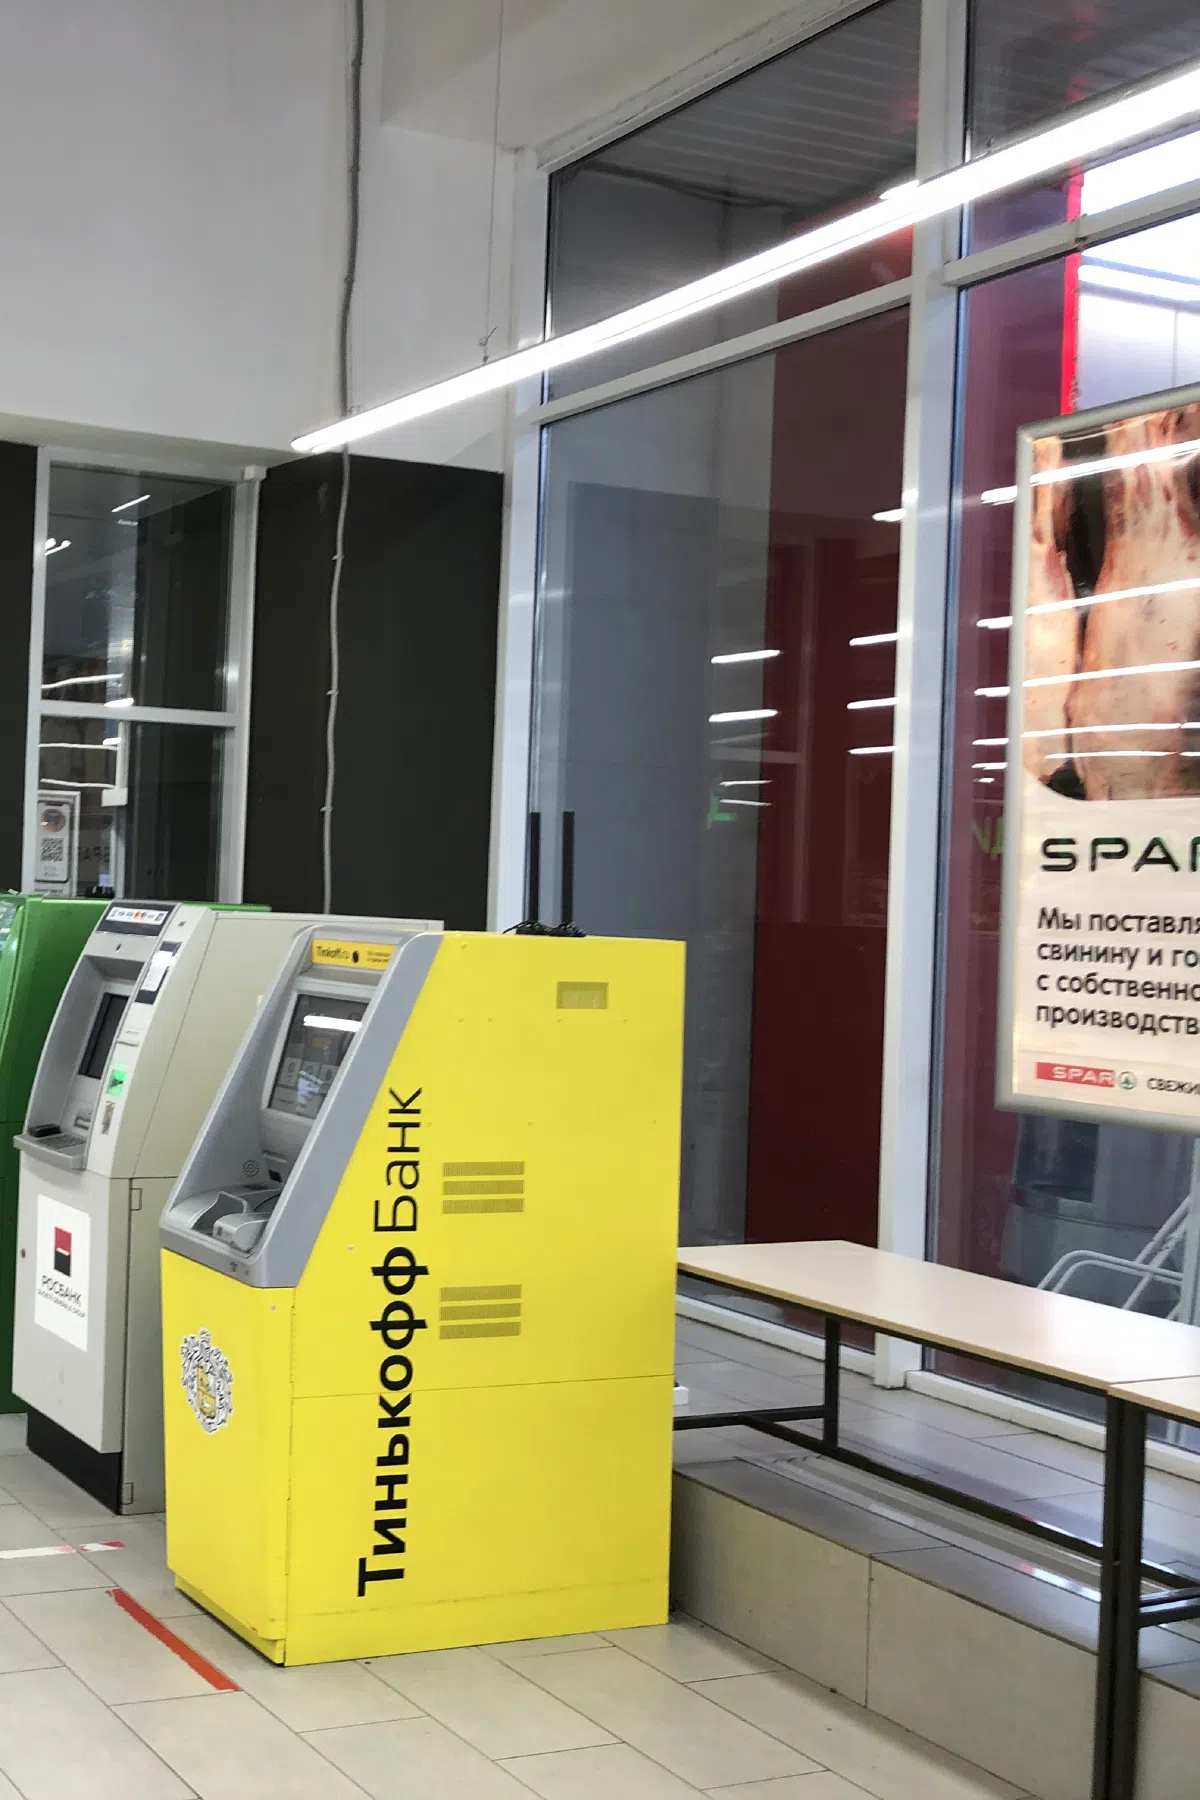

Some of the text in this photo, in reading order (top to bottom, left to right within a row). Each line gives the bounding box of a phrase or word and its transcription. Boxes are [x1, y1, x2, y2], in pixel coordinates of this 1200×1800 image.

[1041, 836, 1200, 872] SPA
[1037, 906, 1081, 931] Мы
[1037, 943, 1200, 971] свинину и го
[1036, 971, 1200, 1001] с собственно
[1052, 1066, 1115, 1086] SPAR
[357, 1086, 429, 1597] Тинькофф Банк
